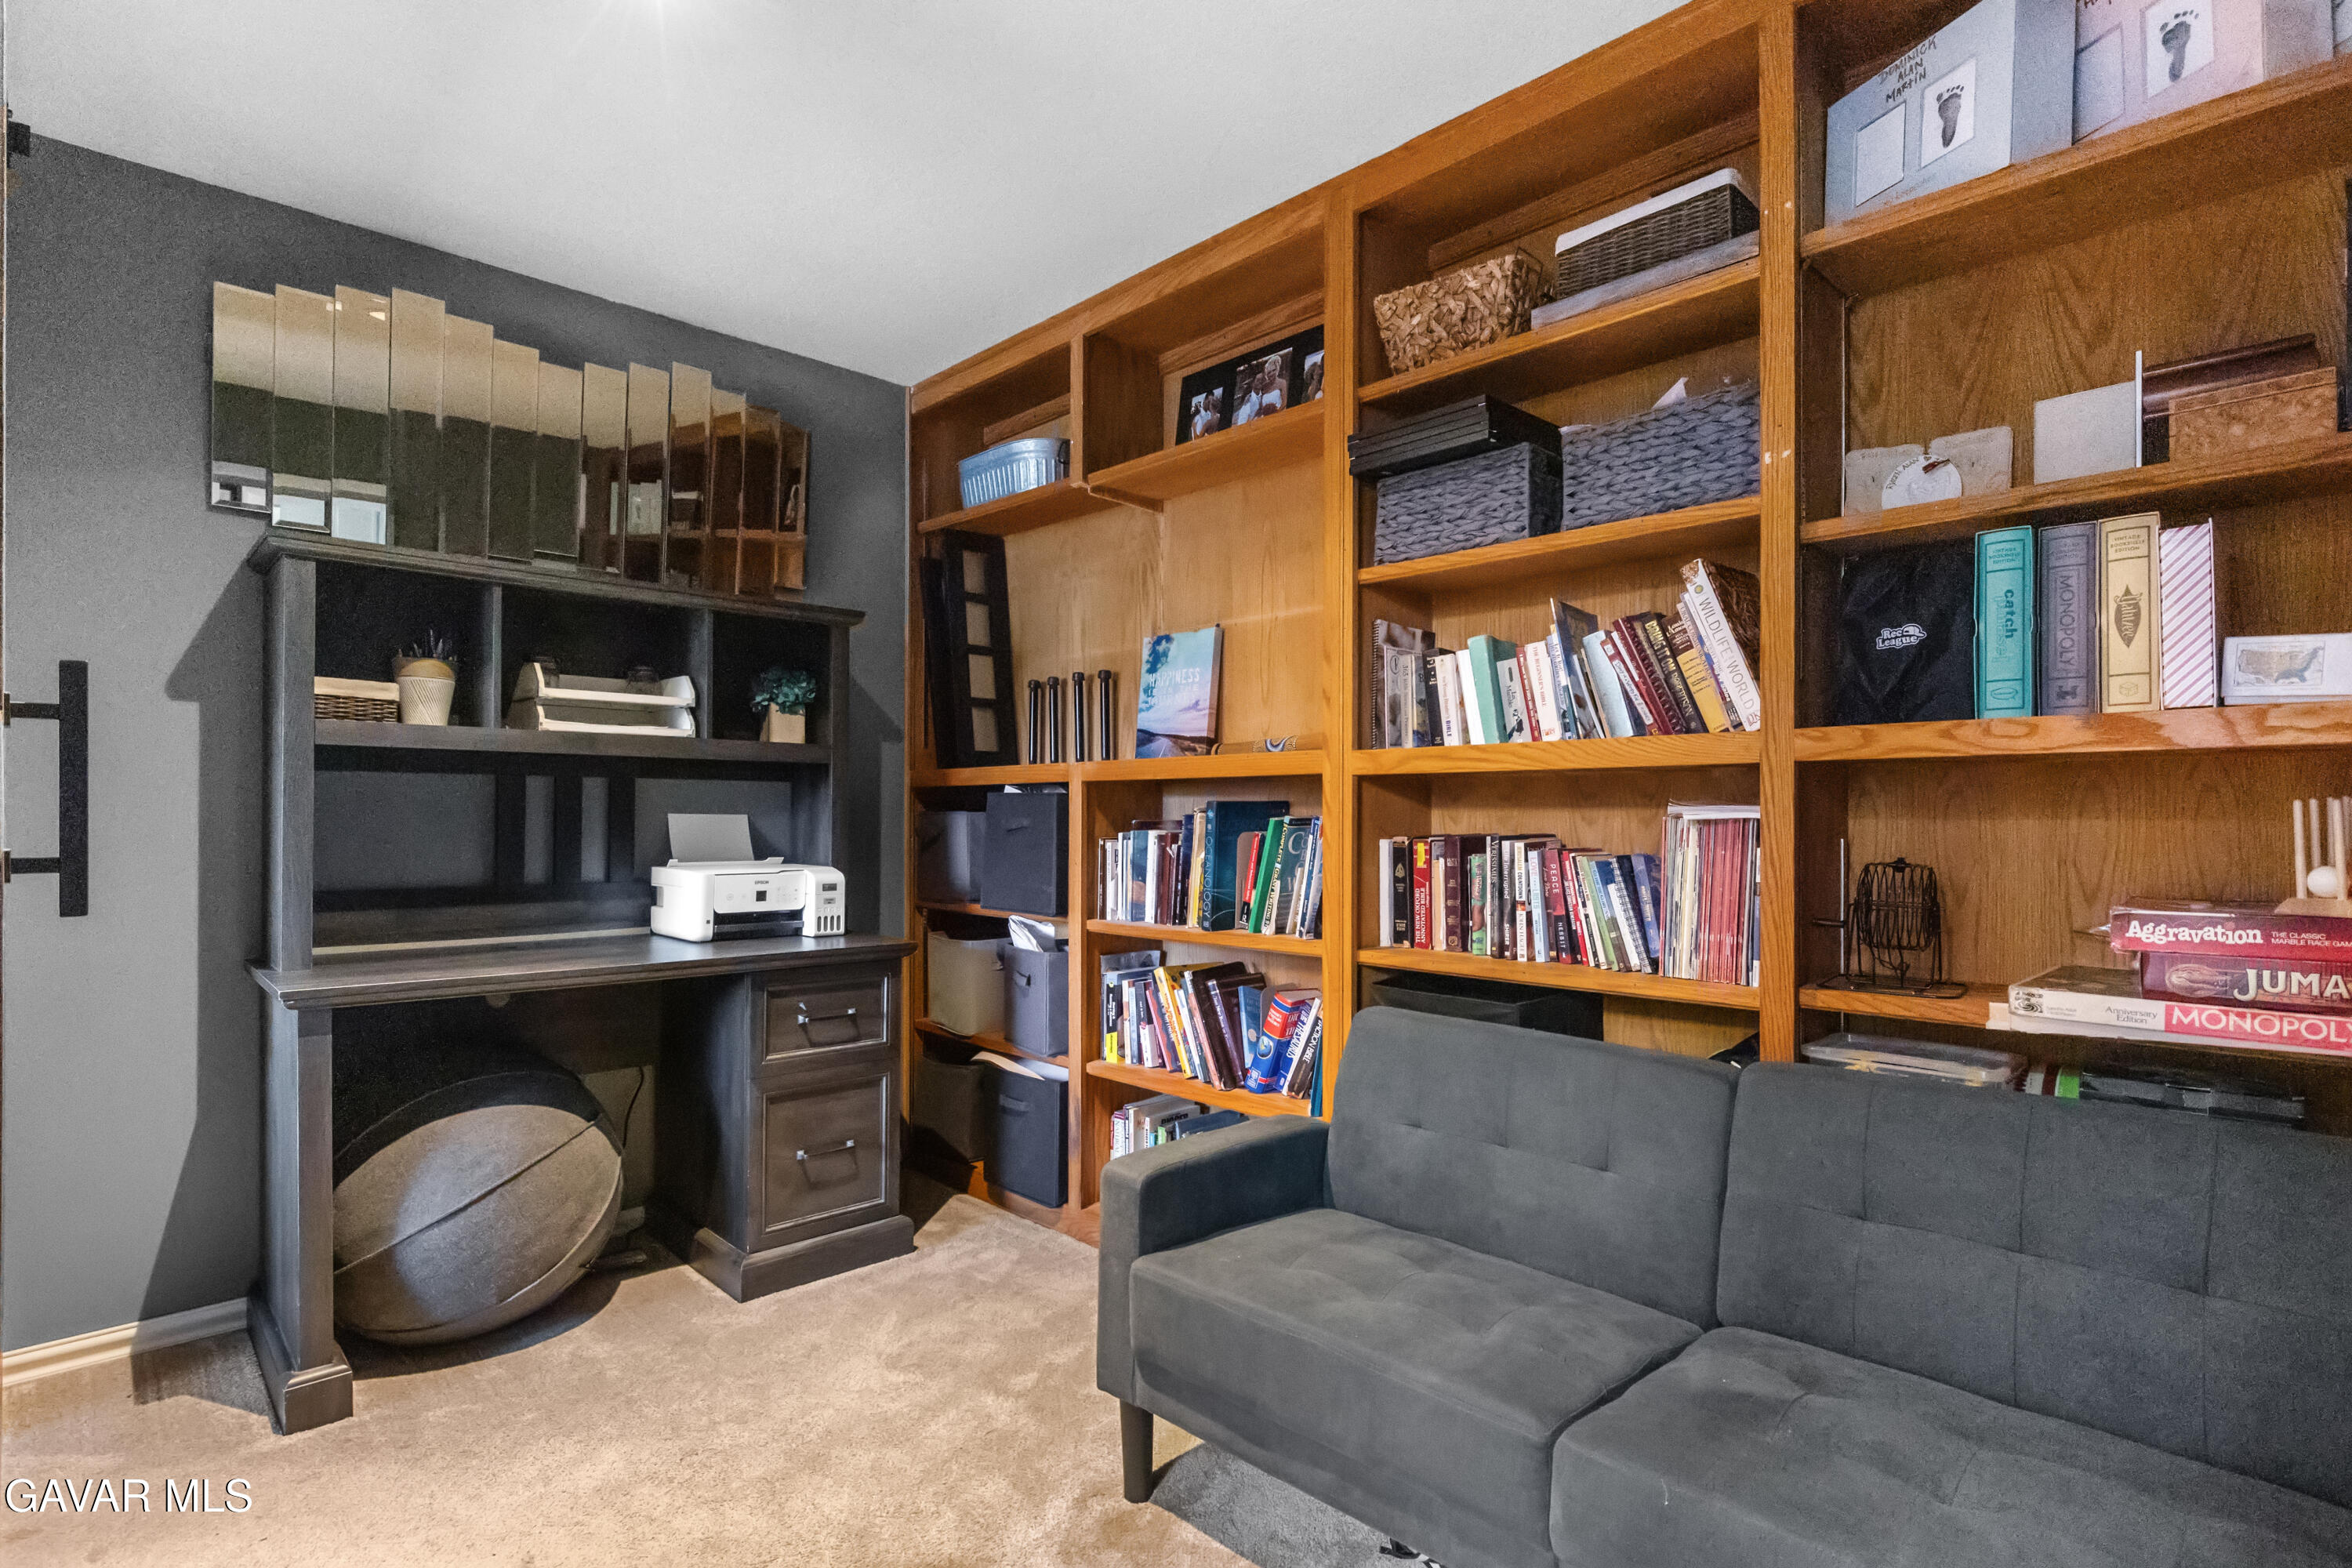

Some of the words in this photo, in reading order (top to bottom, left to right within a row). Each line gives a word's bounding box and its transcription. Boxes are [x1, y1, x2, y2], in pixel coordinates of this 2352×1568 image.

[1897, 58, 1923, 82] ALAN
[2004, 590, 2017, 639] catch
[2059, 575, 2077, 667] MONOPOLY
[1643, 619, 1666, 649] BRING
[1878, 636, 1918, 648] League
[1883, 630, 1902, 639] Rec
[1656, 647, 1670, 659] IT
[1660, 657, 1676, 673] ON
[1697, 597, 1733, 658] WILDLIFE
[1725, 660, 1755, 710] WORLD
[1149, 668, 1200, 686] HAPPINESS
[1666, 672, 1693, 717] ROBERTSON
[1276, 827, 1287, 862] COMPLETE
[1203, 836, 1212, 917] OCEANOLOGY
[1271, 867, 1279, 890] GRANT
[1550, 863, 1559, 894] PEACE
[1265, 891, 1275, 920] WRITING
[2125, 920, 2263, 944] Aggravation
[2234, 968, 2351, 1002] JUMA
[2105, 1006, 2158, 1020] Anniversary
[2116, 1014, 2148, 1024] Edition
[1286, 1022, 1305, 1059] THESAURUS
[1301, 1046, 1313, 1063] BIBLE
